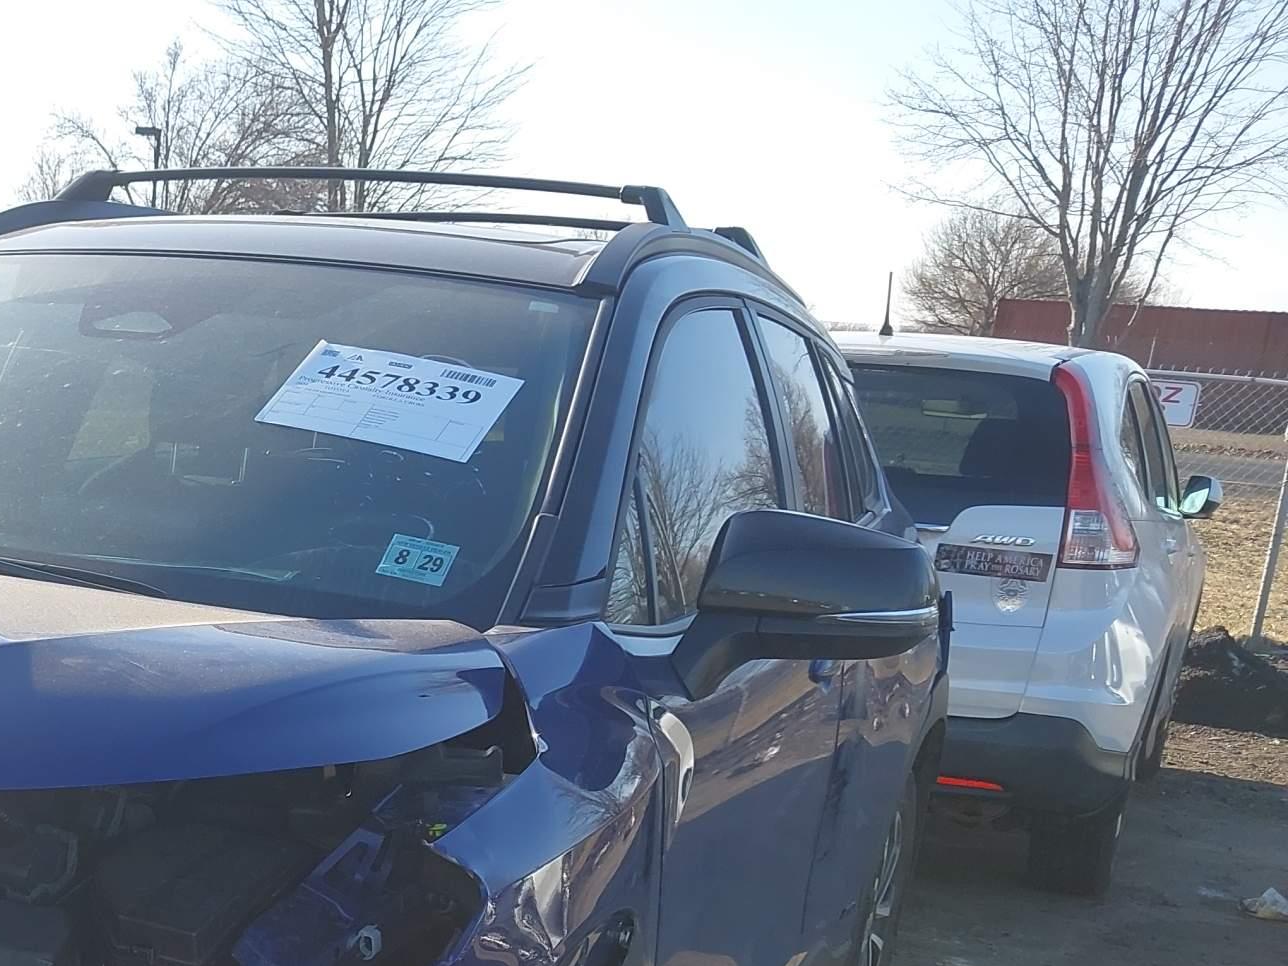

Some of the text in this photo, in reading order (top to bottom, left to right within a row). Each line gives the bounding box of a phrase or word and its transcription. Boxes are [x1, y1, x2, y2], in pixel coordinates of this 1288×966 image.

[317, 364, 482, 404] 44578339
[970, 534, 1036, 546] AWD
[394, 549, 410, 565] 8
[417, 554, 444, 573] 29
[966, 550, 992, 563] HELP
